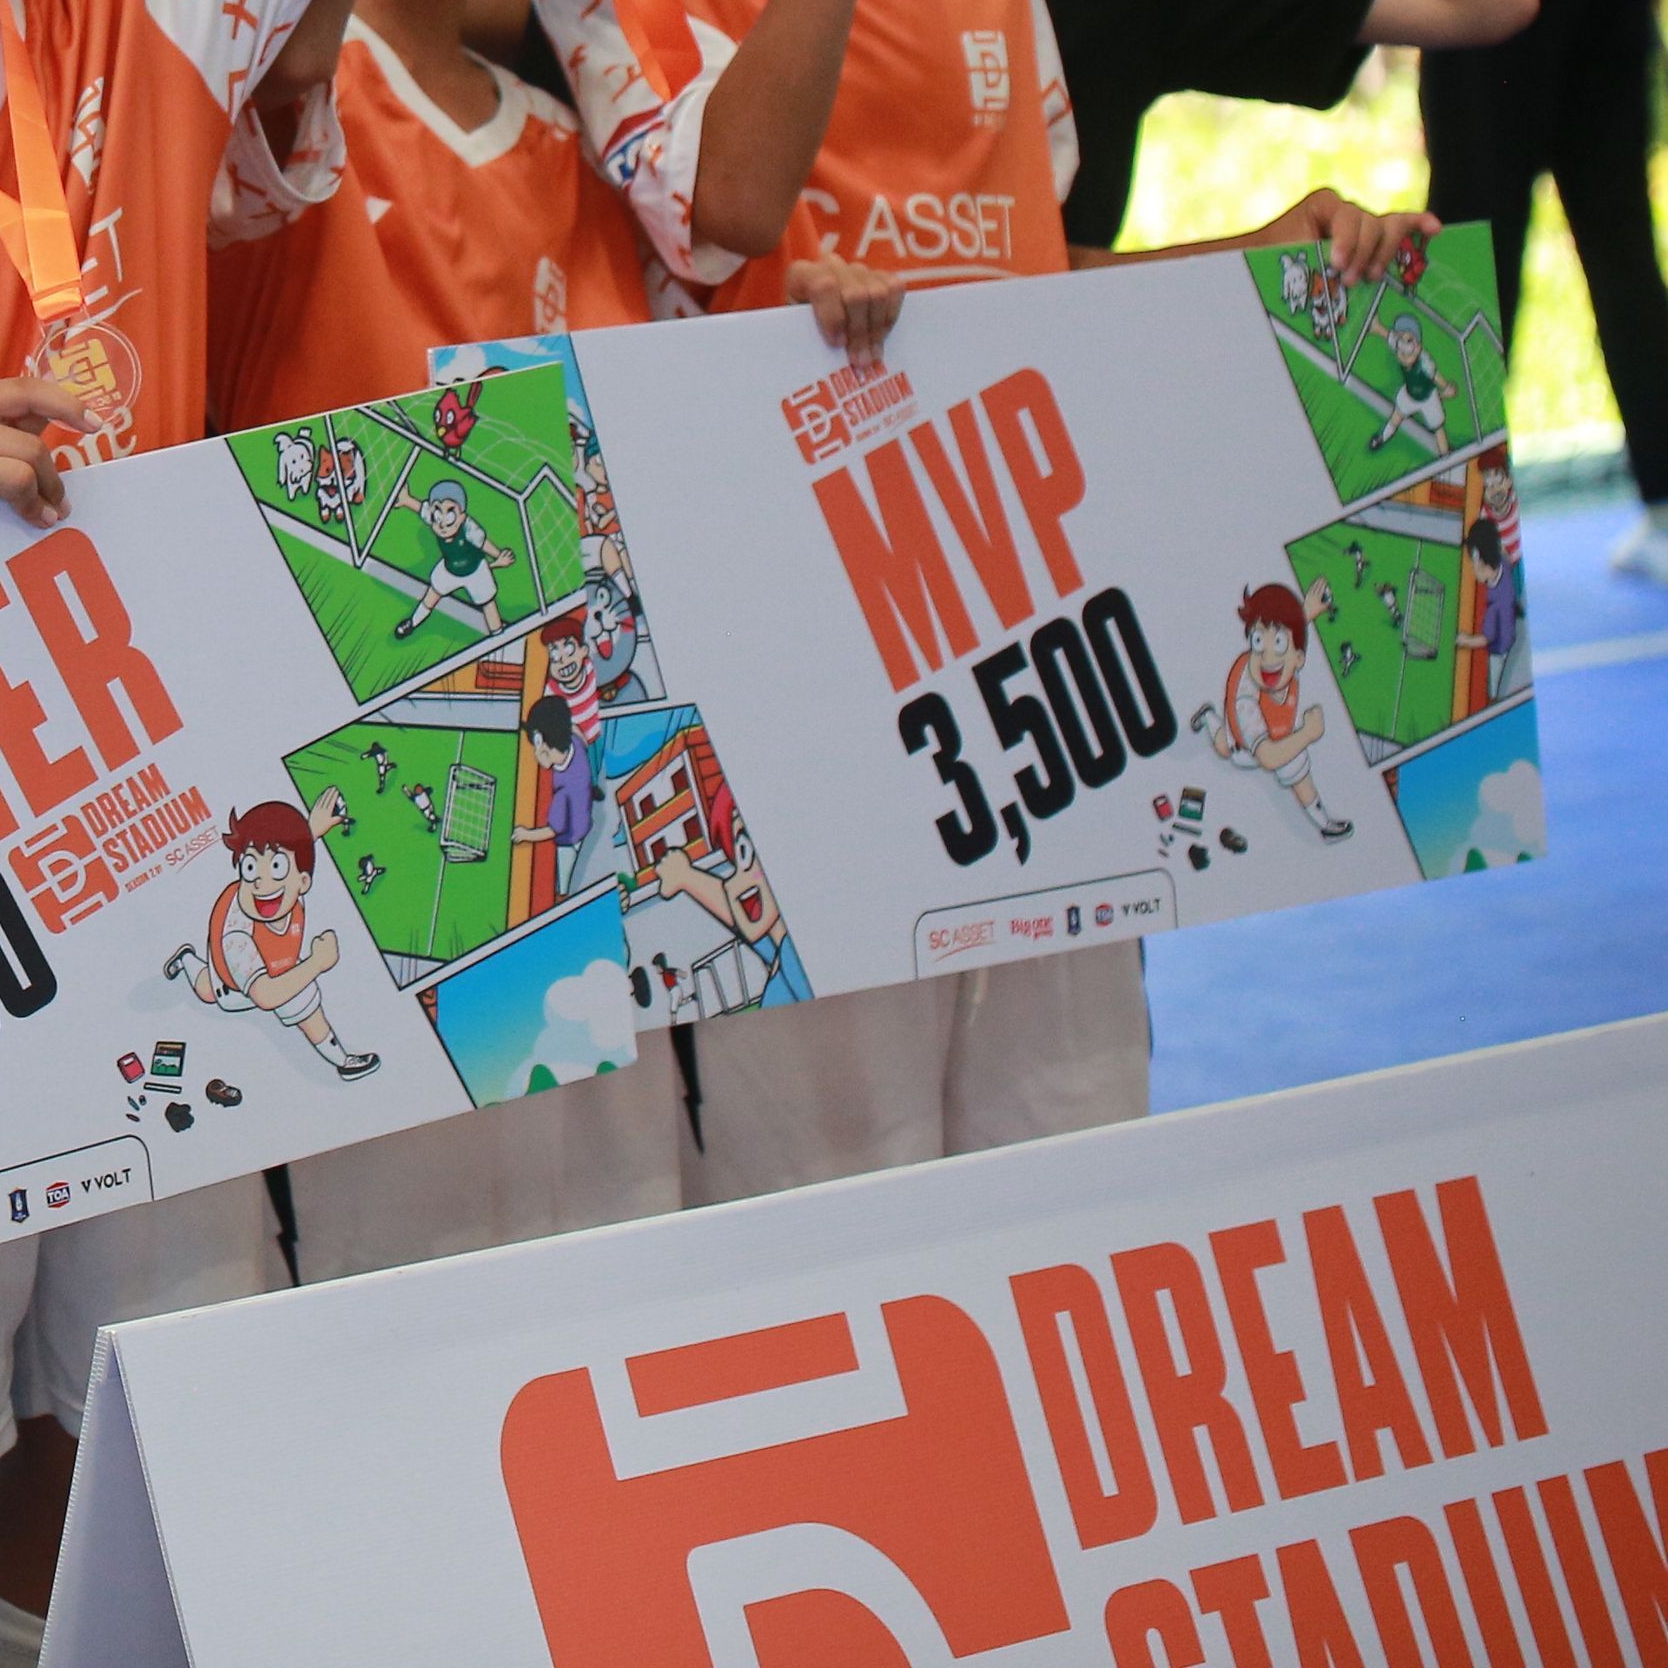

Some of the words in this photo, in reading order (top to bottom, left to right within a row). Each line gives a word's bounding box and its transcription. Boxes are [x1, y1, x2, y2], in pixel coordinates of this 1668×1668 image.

[855, 192, 1016, 262] ASSET
[842, 370, 914, 427] STADIUM
[811, 366, 1087, 694] MVP
[898, 586, 1179, 867] 3,500
[80, 762, 172, 839] DREAM
[101, 785, 213, 874] STADIUM
[165, 847, 185, 867] SC
[185, 824, 221, 855] ASSET
[1132, 898, 1161, 915] VOLT
[929, 929, 952, 950] SC
[47, 1187, 70, 1205] TOA
[94, 1167, 132, 1190] VOLT
[1009, 1175, 1550, 1551] DREAM
